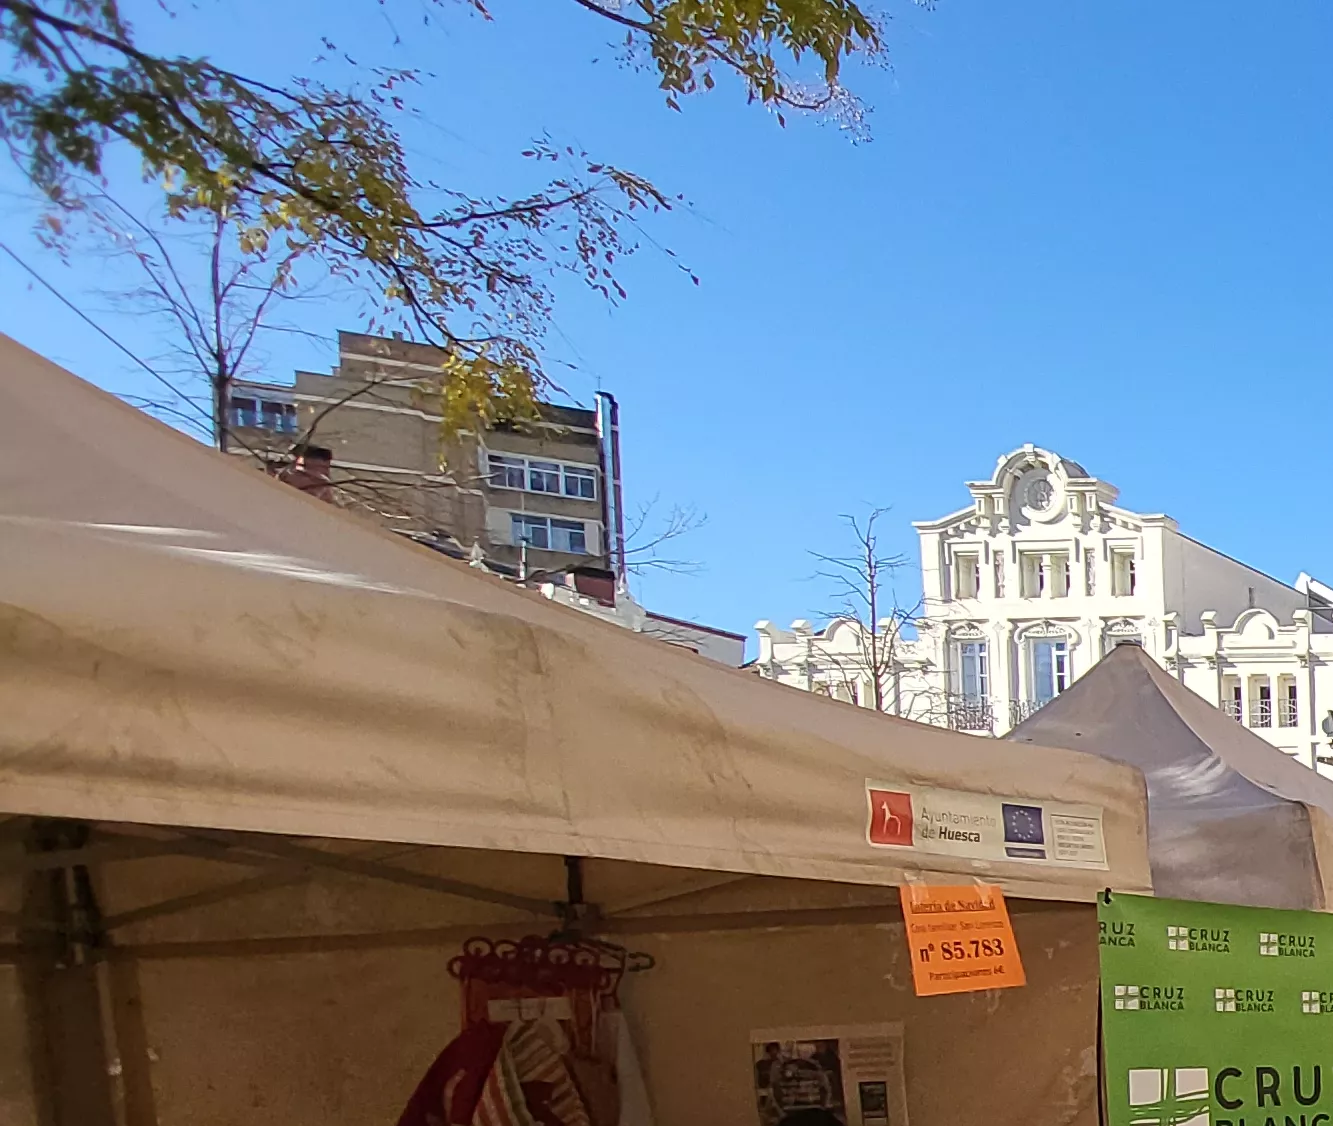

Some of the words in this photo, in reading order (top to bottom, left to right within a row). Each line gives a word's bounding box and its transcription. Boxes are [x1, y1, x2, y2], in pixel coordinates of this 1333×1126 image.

[921, 807, 996, 828] Ayuntamiento
[921, 824, 936, 839] de
[938, 826, 981, 843] Huesca
[1188, 928, 1230, 942] CRUZ
[1278, 934, 1315, 948] CRUZ
[940, 938, 1004, 960] 85.783
[1188, 940, 1230, 953] BLANCA
[1278, 946, 1315, 958] BLANCA
[1139, 986, 1185, 999] CRUZ
[1235, 989, 1274, 1002] CRUZ
[1139, 1000, 1185, 1011] BLANCA
[1235, 1001, 1274, 1012] BLANCA
